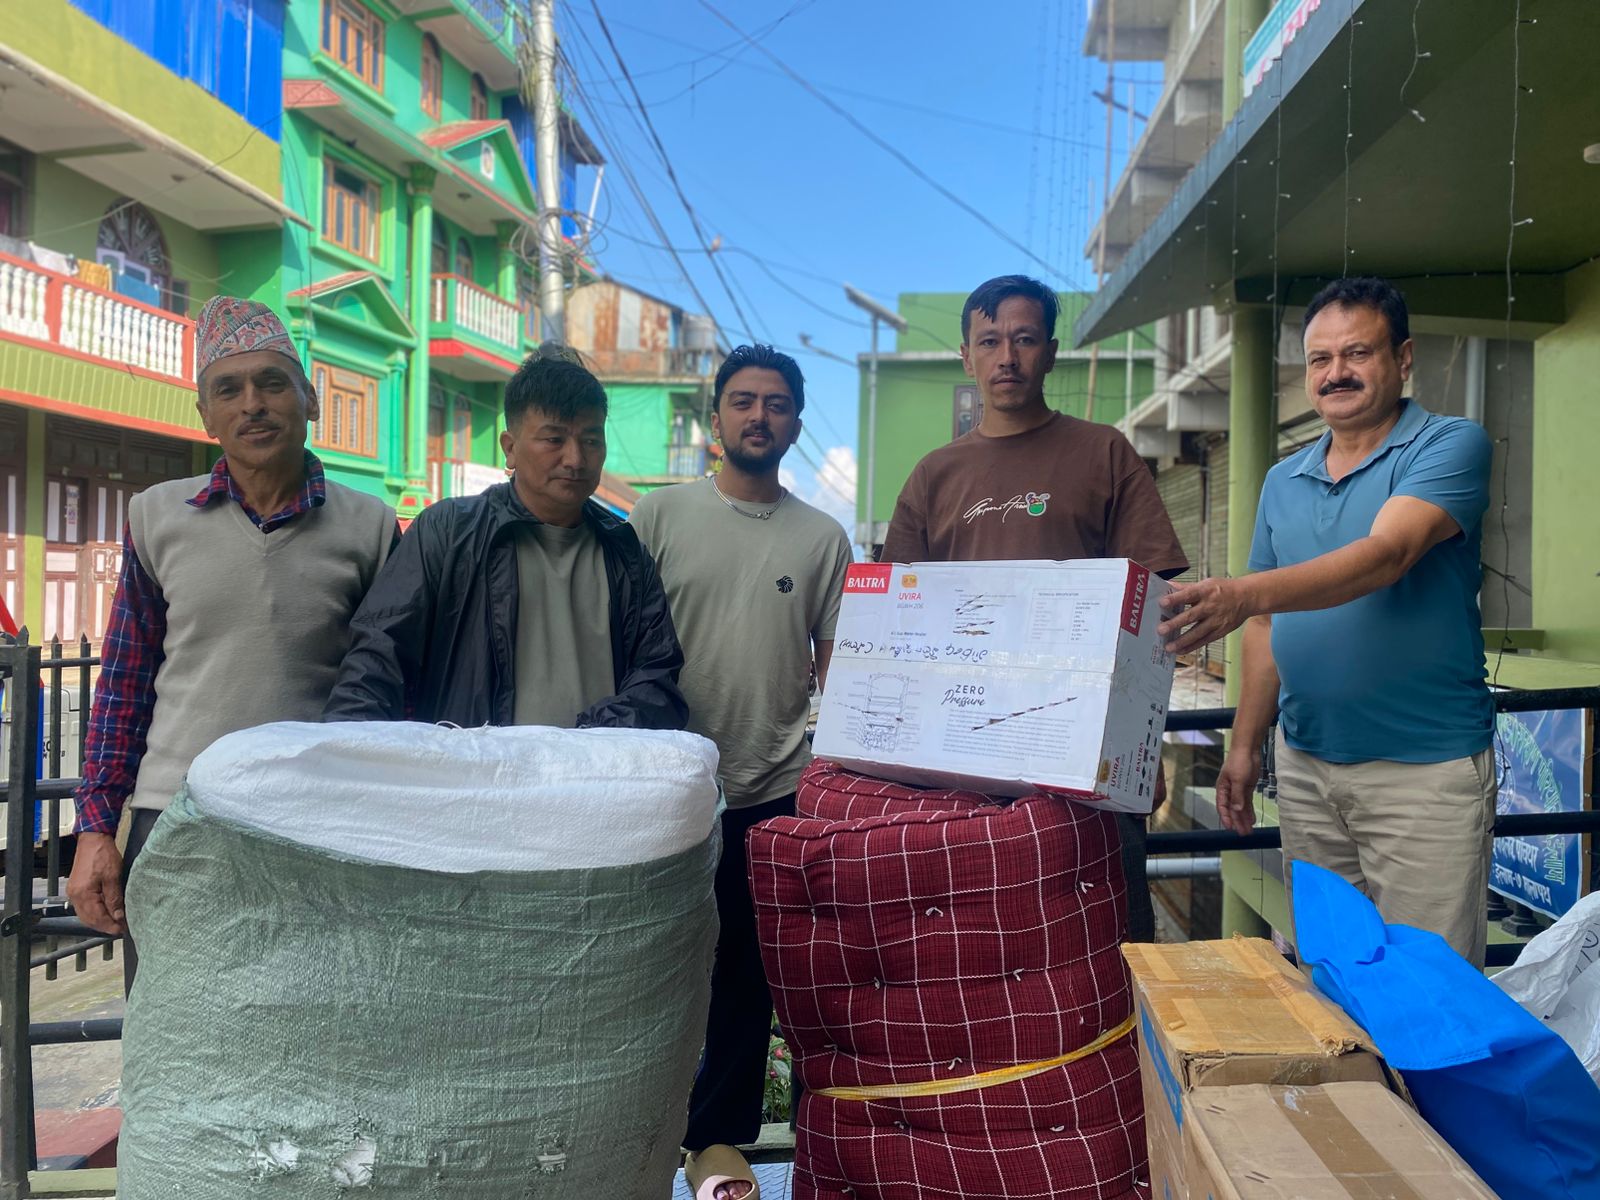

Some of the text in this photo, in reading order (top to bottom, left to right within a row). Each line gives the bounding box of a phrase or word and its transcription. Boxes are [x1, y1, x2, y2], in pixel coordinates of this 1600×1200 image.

[847, 577, 886, 588] BALTRA
[898, 592, 922, 601] UVIRA
[1129, 574, 1145, 629] BALTRA
[955, 685, 985, 695] ZERO
[941, 689, 986, 707] Pressure
[1110, 756, 1121, 787] UVIRA
